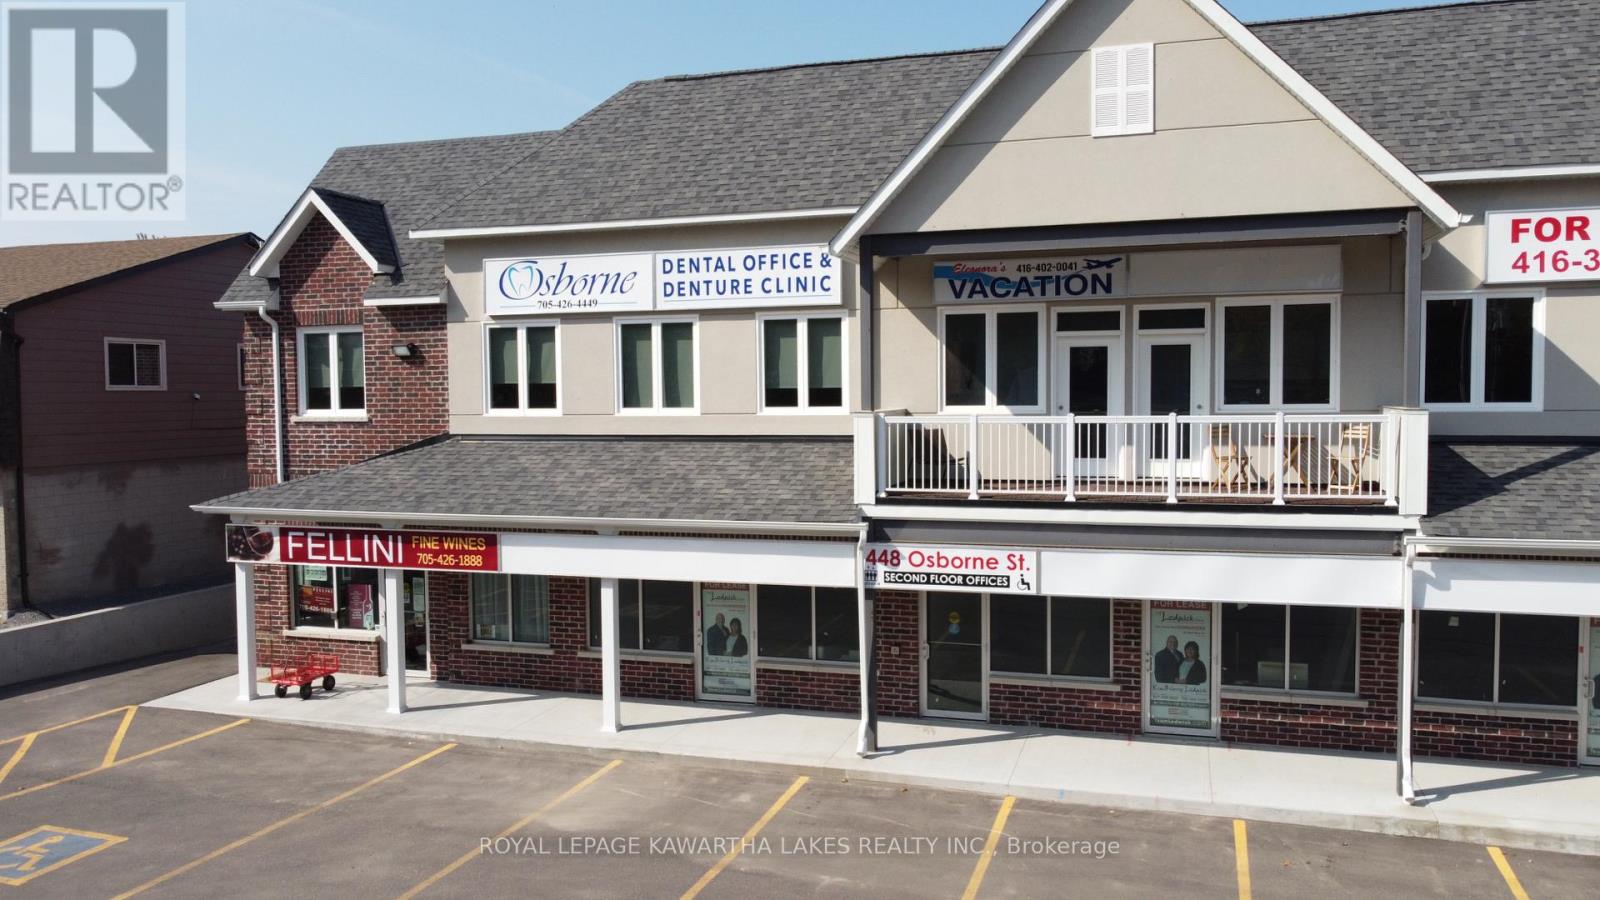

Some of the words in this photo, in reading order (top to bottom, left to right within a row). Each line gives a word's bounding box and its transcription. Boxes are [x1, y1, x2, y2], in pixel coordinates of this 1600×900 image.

[1511, 215, 1591, 243] FOR
[662, 256, 736, 274] DENTAL
[743, 252, 812, 271] OFFICE
[820, 253, 832, 268] &
[1016, 262, 1078, 273] 416-402-0041
[499, 260, 638, 301] Osborne
[663, 278, 753, 297] DENTURE
[761, 275, 832, 294] CLINIC
[948, 273, 1113, 299] VACATION
[538, 299, 598, 309] 705-426-4449
[288, 532, 403, 564] FELLINI
[411, 535, 440, 550] FINE
[443, 536, 487, 551] WINES
[416, 553, 483, 567] 705-426-1888
[865, 549, 901, 567] 448
[908, 550, 999, 570] Osborne
[1007, 553, 1030, 571] St.
[884, 572, 927, 584] SECOND
[930, 574, 963, 586] FLOOR
[966, 575, 1008, 587] OFFICES
